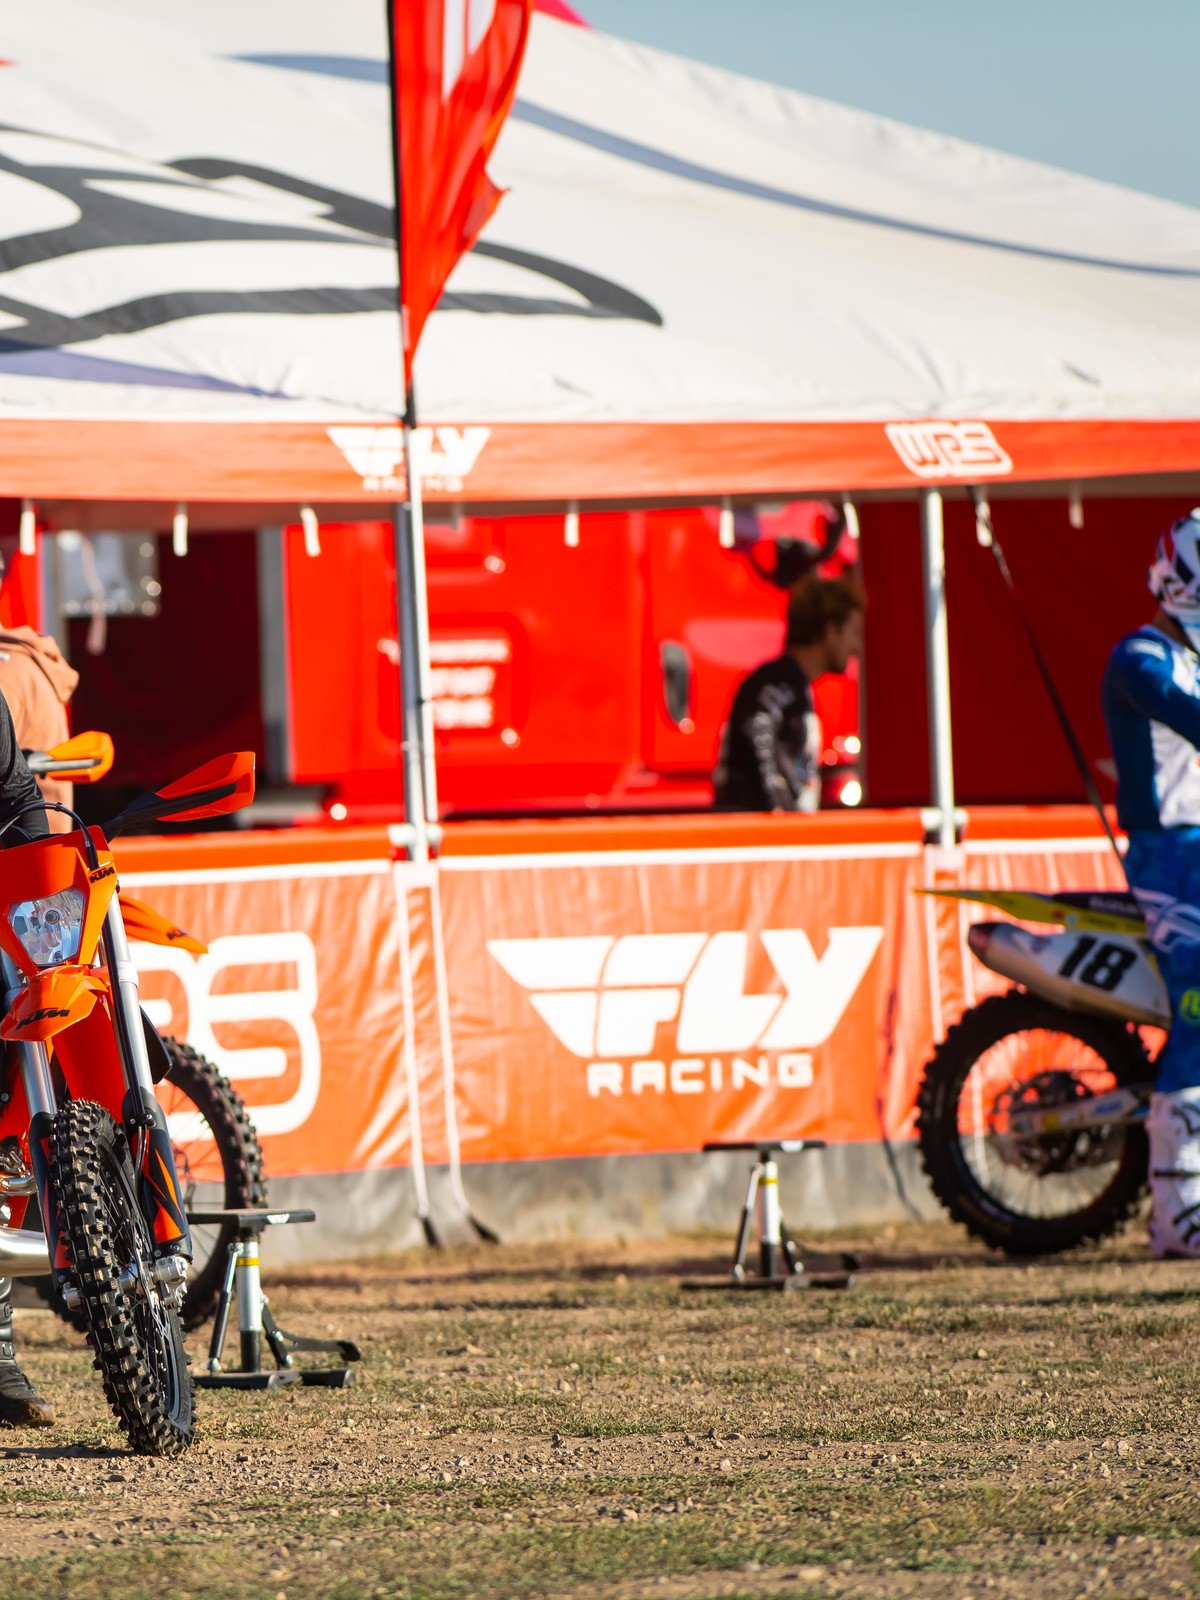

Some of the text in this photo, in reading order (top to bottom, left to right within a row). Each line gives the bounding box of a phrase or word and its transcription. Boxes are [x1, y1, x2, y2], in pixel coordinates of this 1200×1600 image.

[88, 866, 116, 884] KTM
[1058, 933, 1138, 991] 18
[486, 925, 885, 1058] FLY
[586, 1054, 814, 1099] RACING
